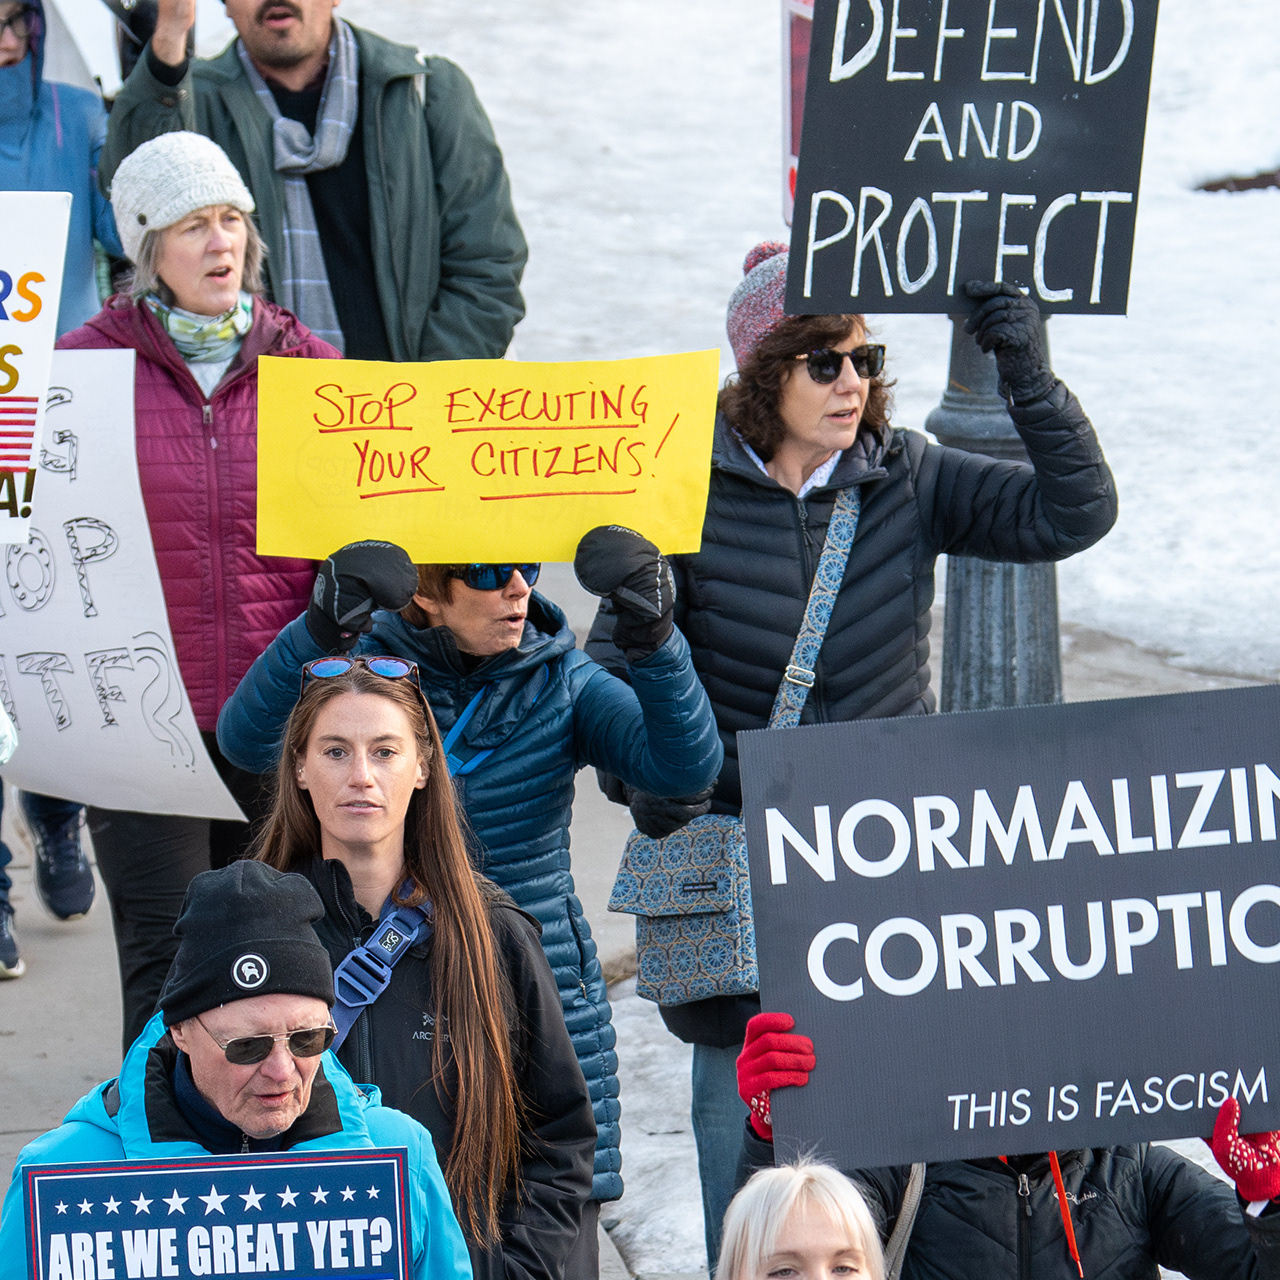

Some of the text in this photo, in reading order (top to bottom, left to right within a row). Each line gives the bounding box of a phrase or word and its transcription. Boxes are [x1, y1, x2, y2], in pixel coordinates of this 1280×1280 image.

[829, 0, 1134, 84] DEFEND
[904, 100, 1043, 162] AND
[803, 186, 1133, 304] PROTECT
[312, 380, 649, 429] STOP EXECUTING
[352, 438, 442, 487] YOUR
[470, 412, 680, 480] CITIZENS!
[947, 1066, 1269, 1130] THIS IS FASCISM
[121, 1227, 178, 1280] WE
[187, 1221, 299, 1276] GREAT
[306, 1217, 393, 1270] YET?
